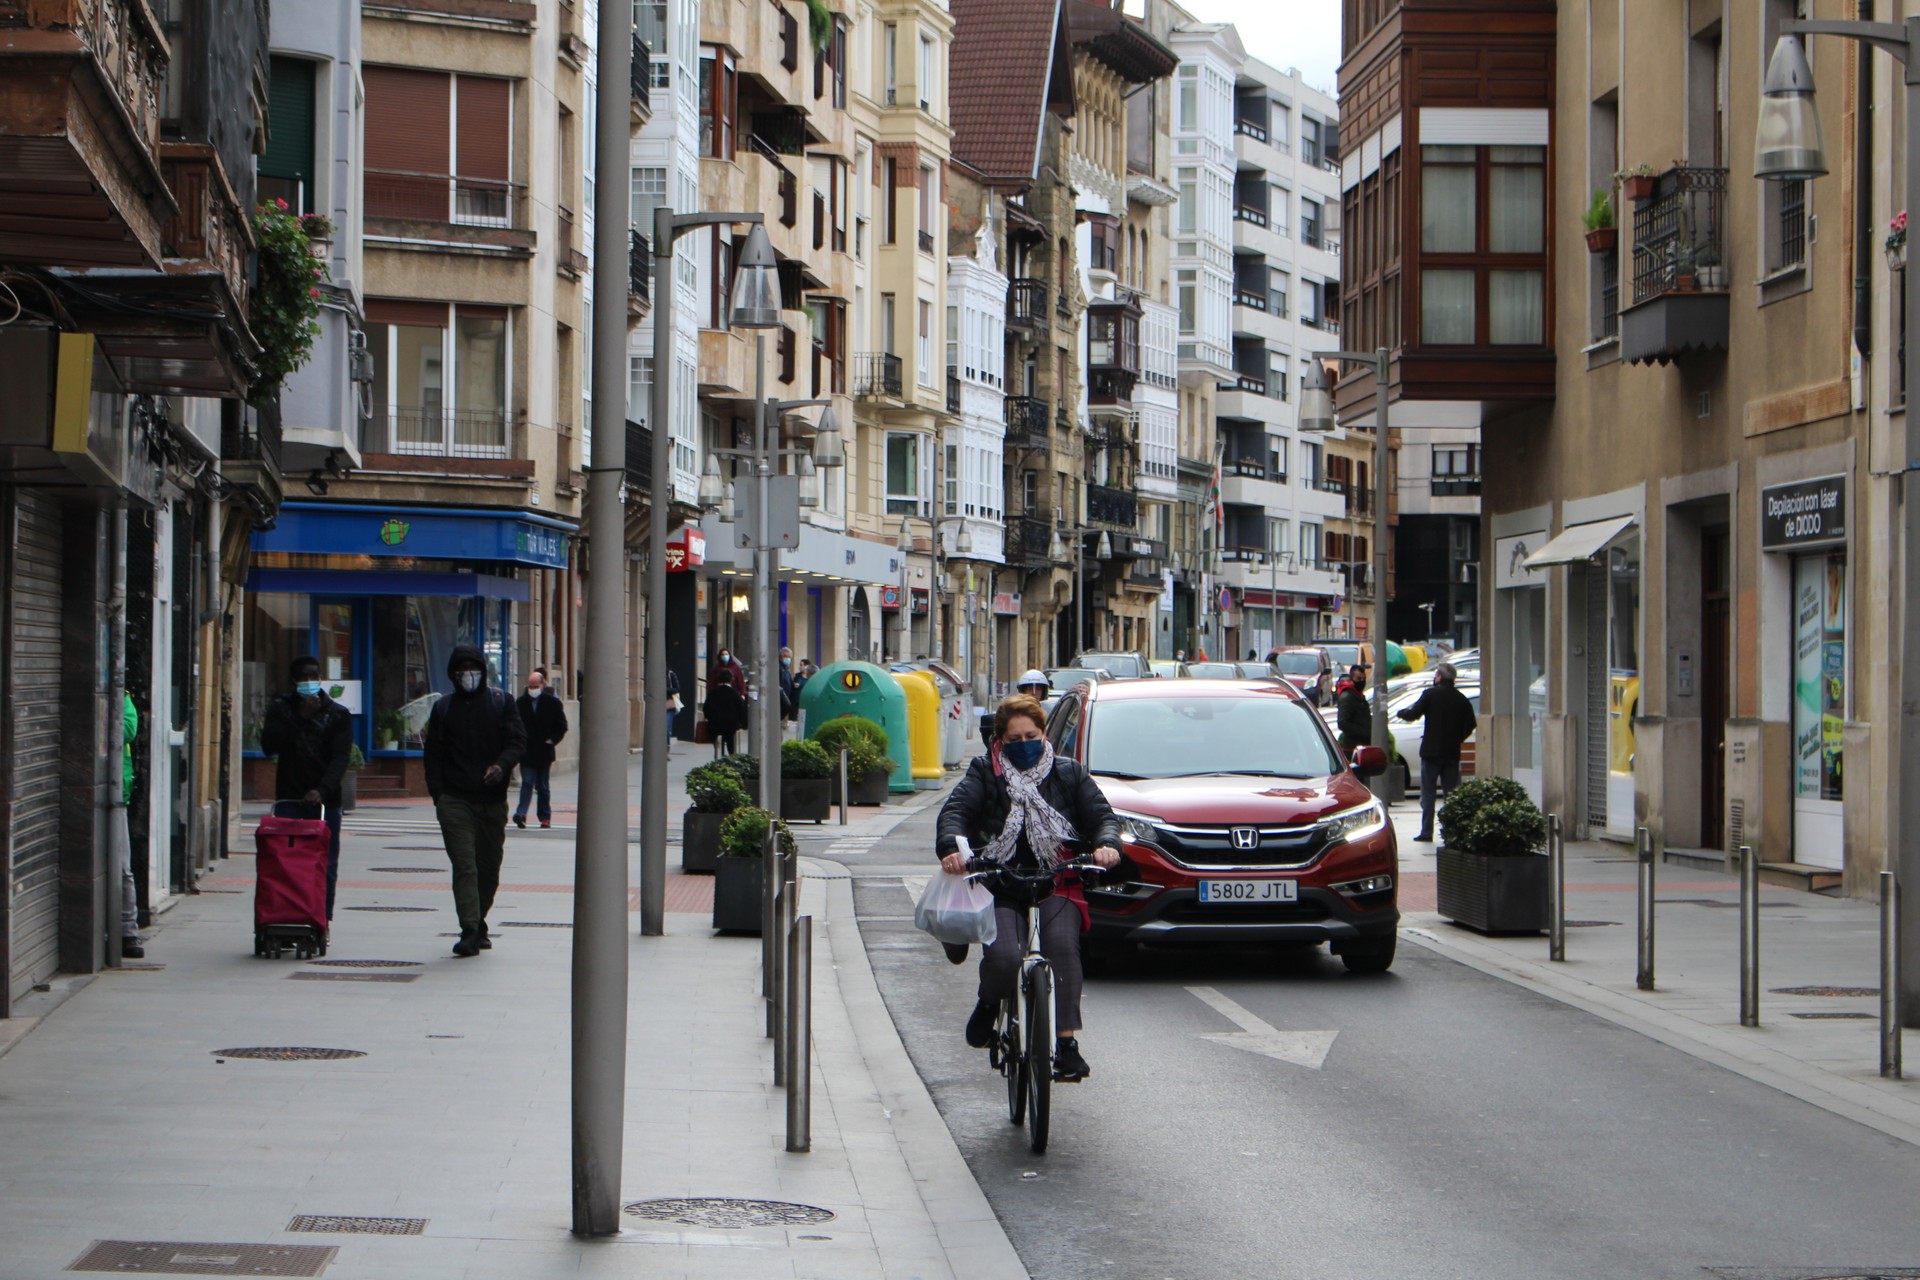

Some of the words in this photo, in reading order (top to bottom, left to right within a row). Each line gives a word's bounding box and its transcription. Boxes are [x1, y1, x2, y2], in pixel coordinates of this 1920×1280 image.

[1768, 493, 1805, 519] Depilación
[1805, 494, 1819, 511] con
[1820, 488, 1838, 508] láser
[1785, 518, 1795, 537] de
[1795, 513, 1822, 536] DIODO
[1211, 883, 1255, 899] 5802
[1262, 883, 1293, 899] JTL
